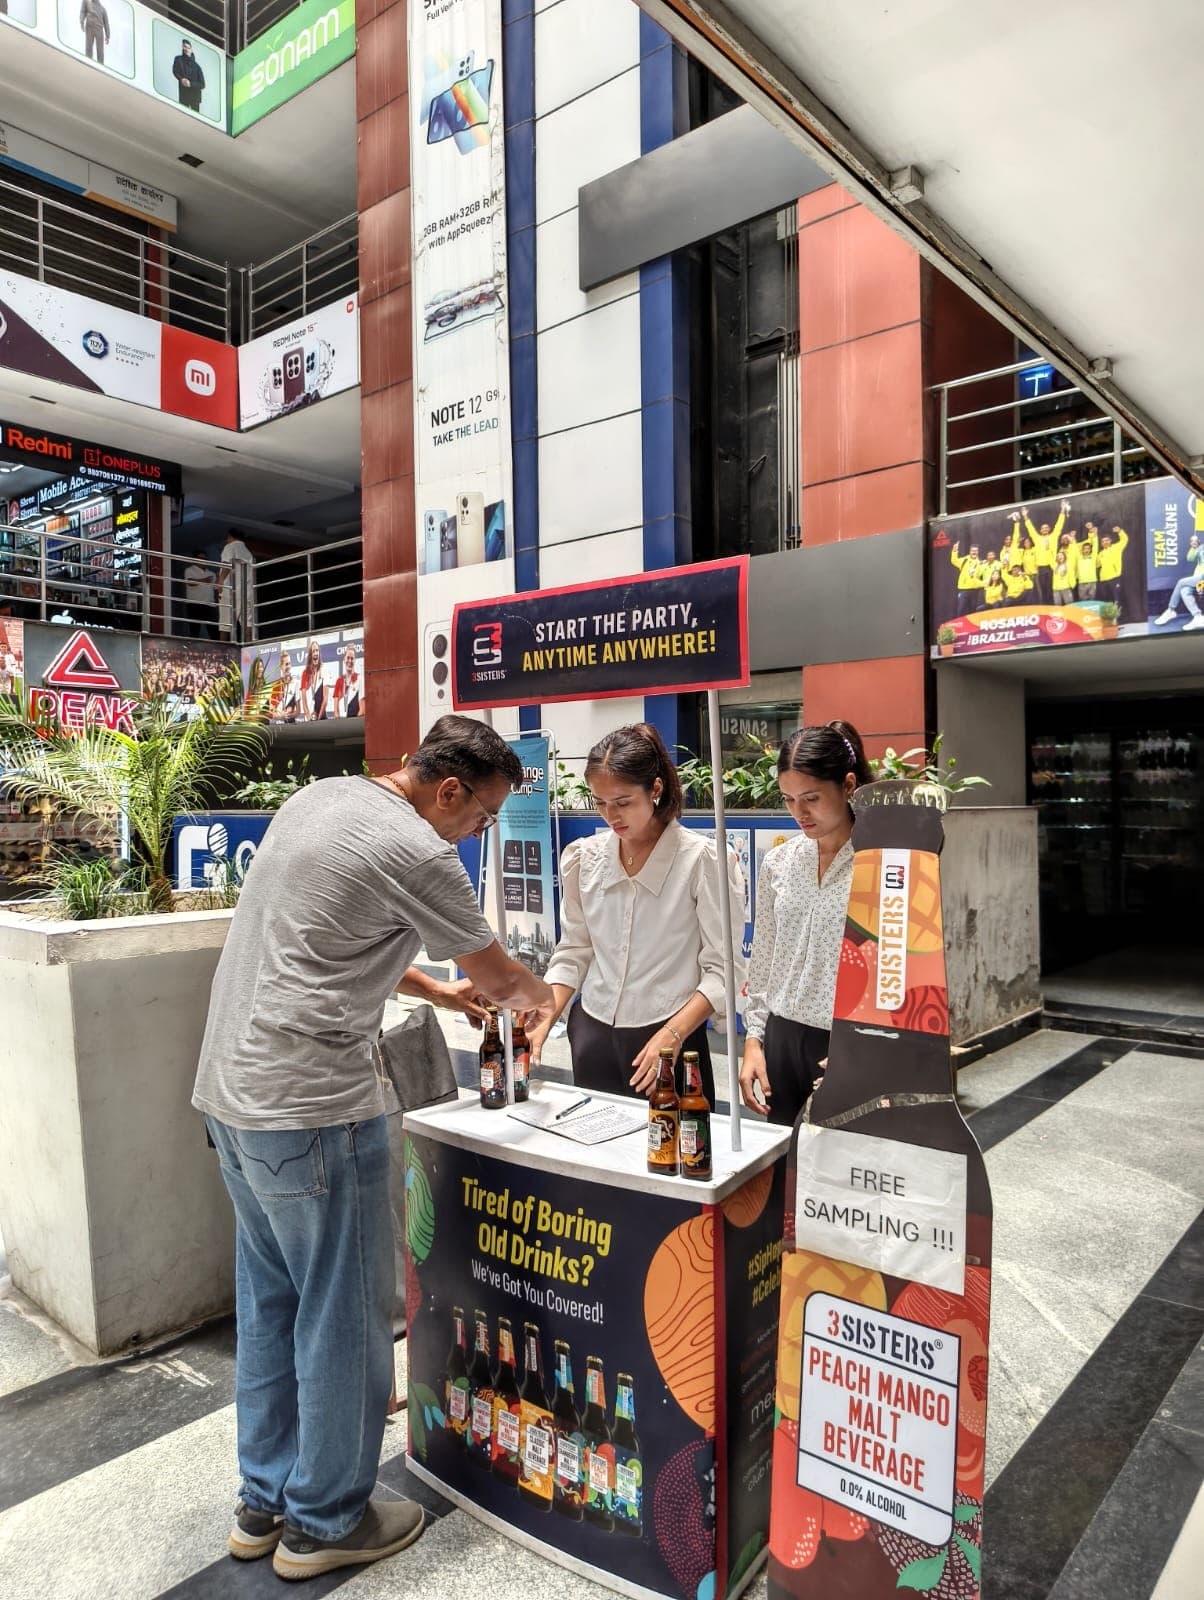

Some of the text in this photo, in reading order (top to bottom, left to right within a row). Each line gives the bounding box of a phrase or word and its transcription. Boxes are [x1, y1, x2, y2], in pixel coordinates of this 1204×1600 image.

[250, 8, 340, 99] SONAM
[424, 222, 437, 238] 2GB
[428, 236, 445, 250] with
[272, 334, 291, 349] REDMI
[291, 328, 306, 341] Note
[431, 401, 465, 429] NOTE
[468, 395, 482, 415] 12
[432, 417, 499, 448] TAKE THE LEAD
[7, 428, 73, 460] Redmi
[102, 455, 161, 479] ONEPLUS
[40, 480, 67, 503] Mobile
[1165, 503, 1178, 566] UKRAINE
[535, 602, 698, 643] START THE PARTY,
[972, 630, 1016, 646] BRAZIL
[522, 629, 717, 672] ANYTIME ANYWHERE!
[28, 687, 140, 740] PEAK
[880, 896, 904, 1006] 3SISTERS
[850, 1167, 906, 1197] FREE
[462, 1177, 612, 1257] Tired of Boring
[804, 1198, 954, 1252] SAMPLING !!!
[478, 1222, 594, 1287] Old Drinks?
[472, 1259, 604, 1325] We've Got You Covered!
[809, 1346, 871, 1397] PEACH
[878, 1371, 950, 1427] MANGO
[848, 1395, 901, 1443] MALT
[823, 1421, 925, 1492] BEVERAGE
[840, 1478, 907, 1521] 0.0% ALCOHOL
